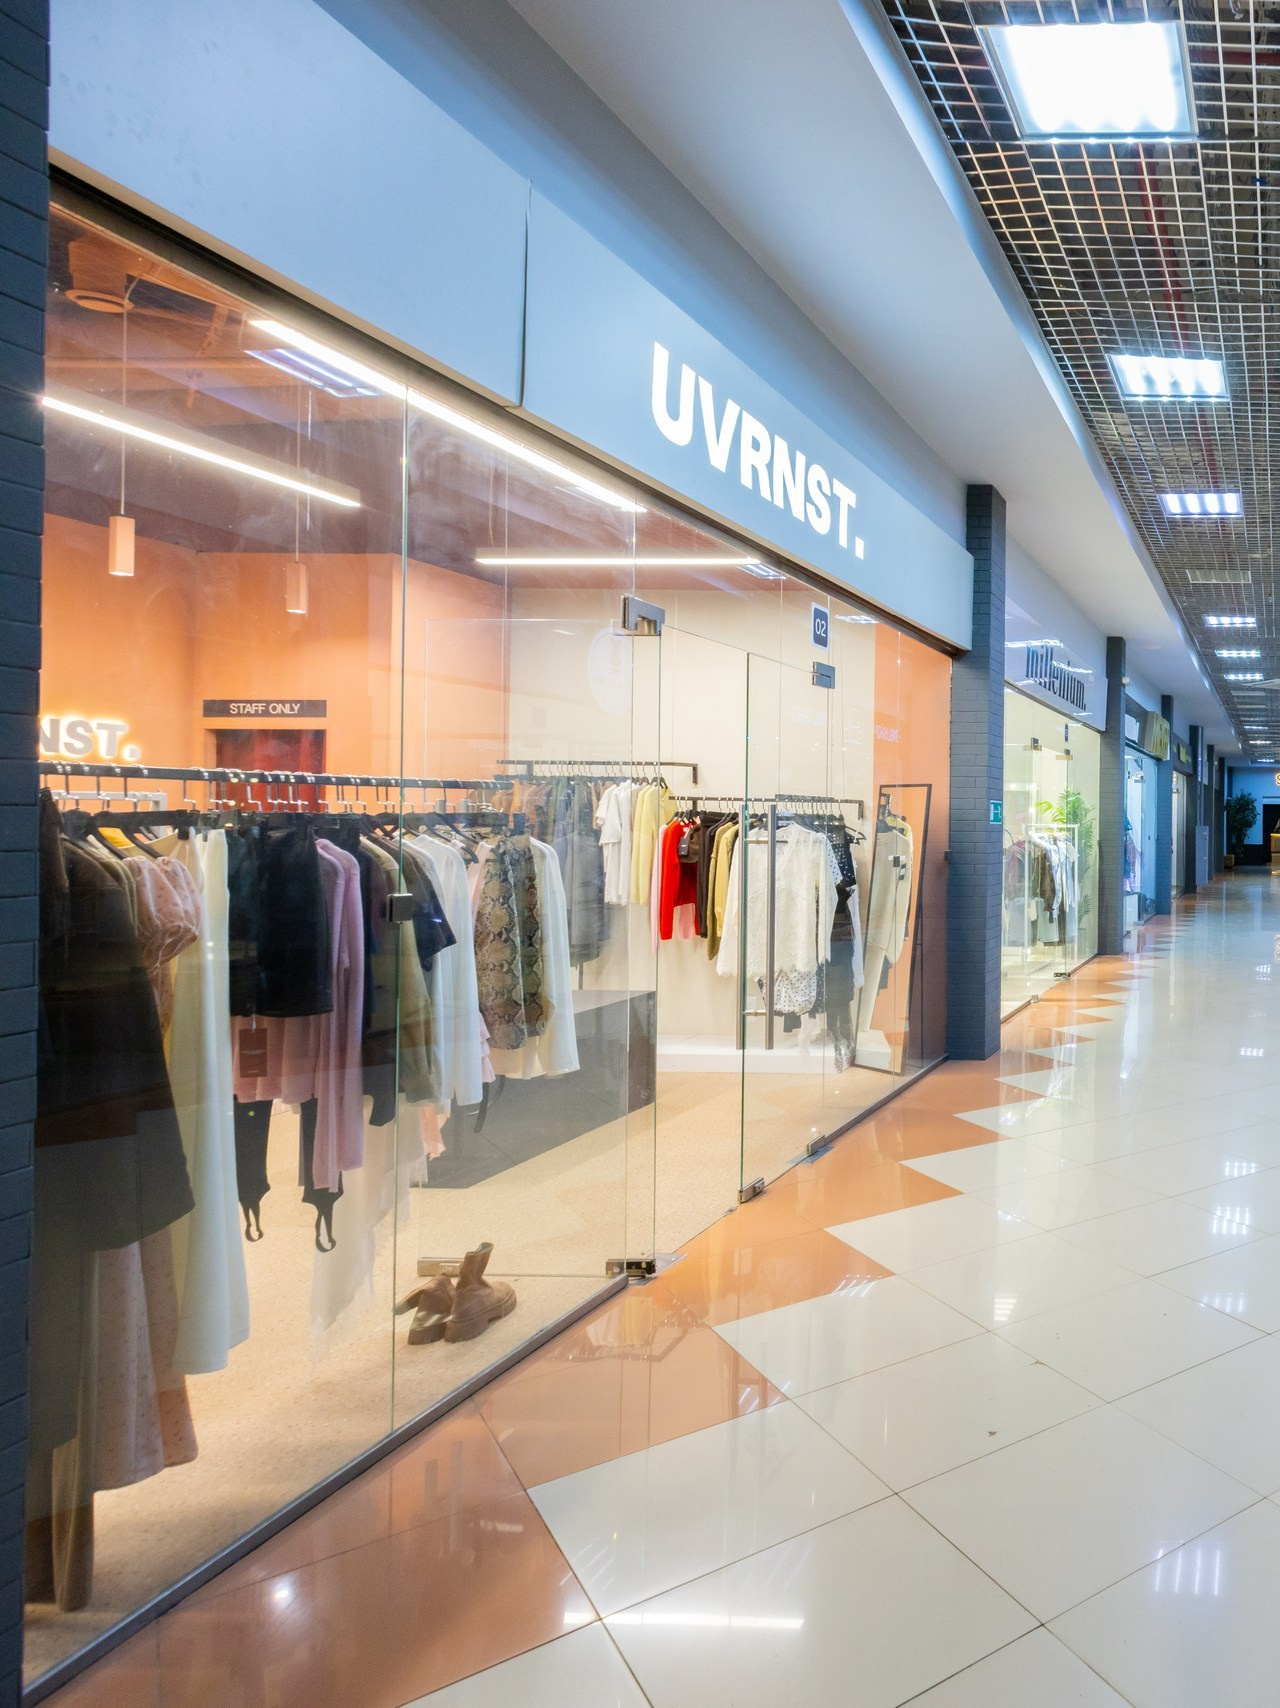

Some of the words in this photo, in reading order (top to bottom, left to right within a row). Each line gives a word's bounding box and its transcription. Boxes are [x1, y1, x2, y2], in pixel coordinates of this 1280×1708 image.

[651, 341, 865, 560] UVRNST.
[815, 617, 826, 637] 02
[229, 703, 266, 714] STAFF
[269, 704, 301, 714] ONLY
